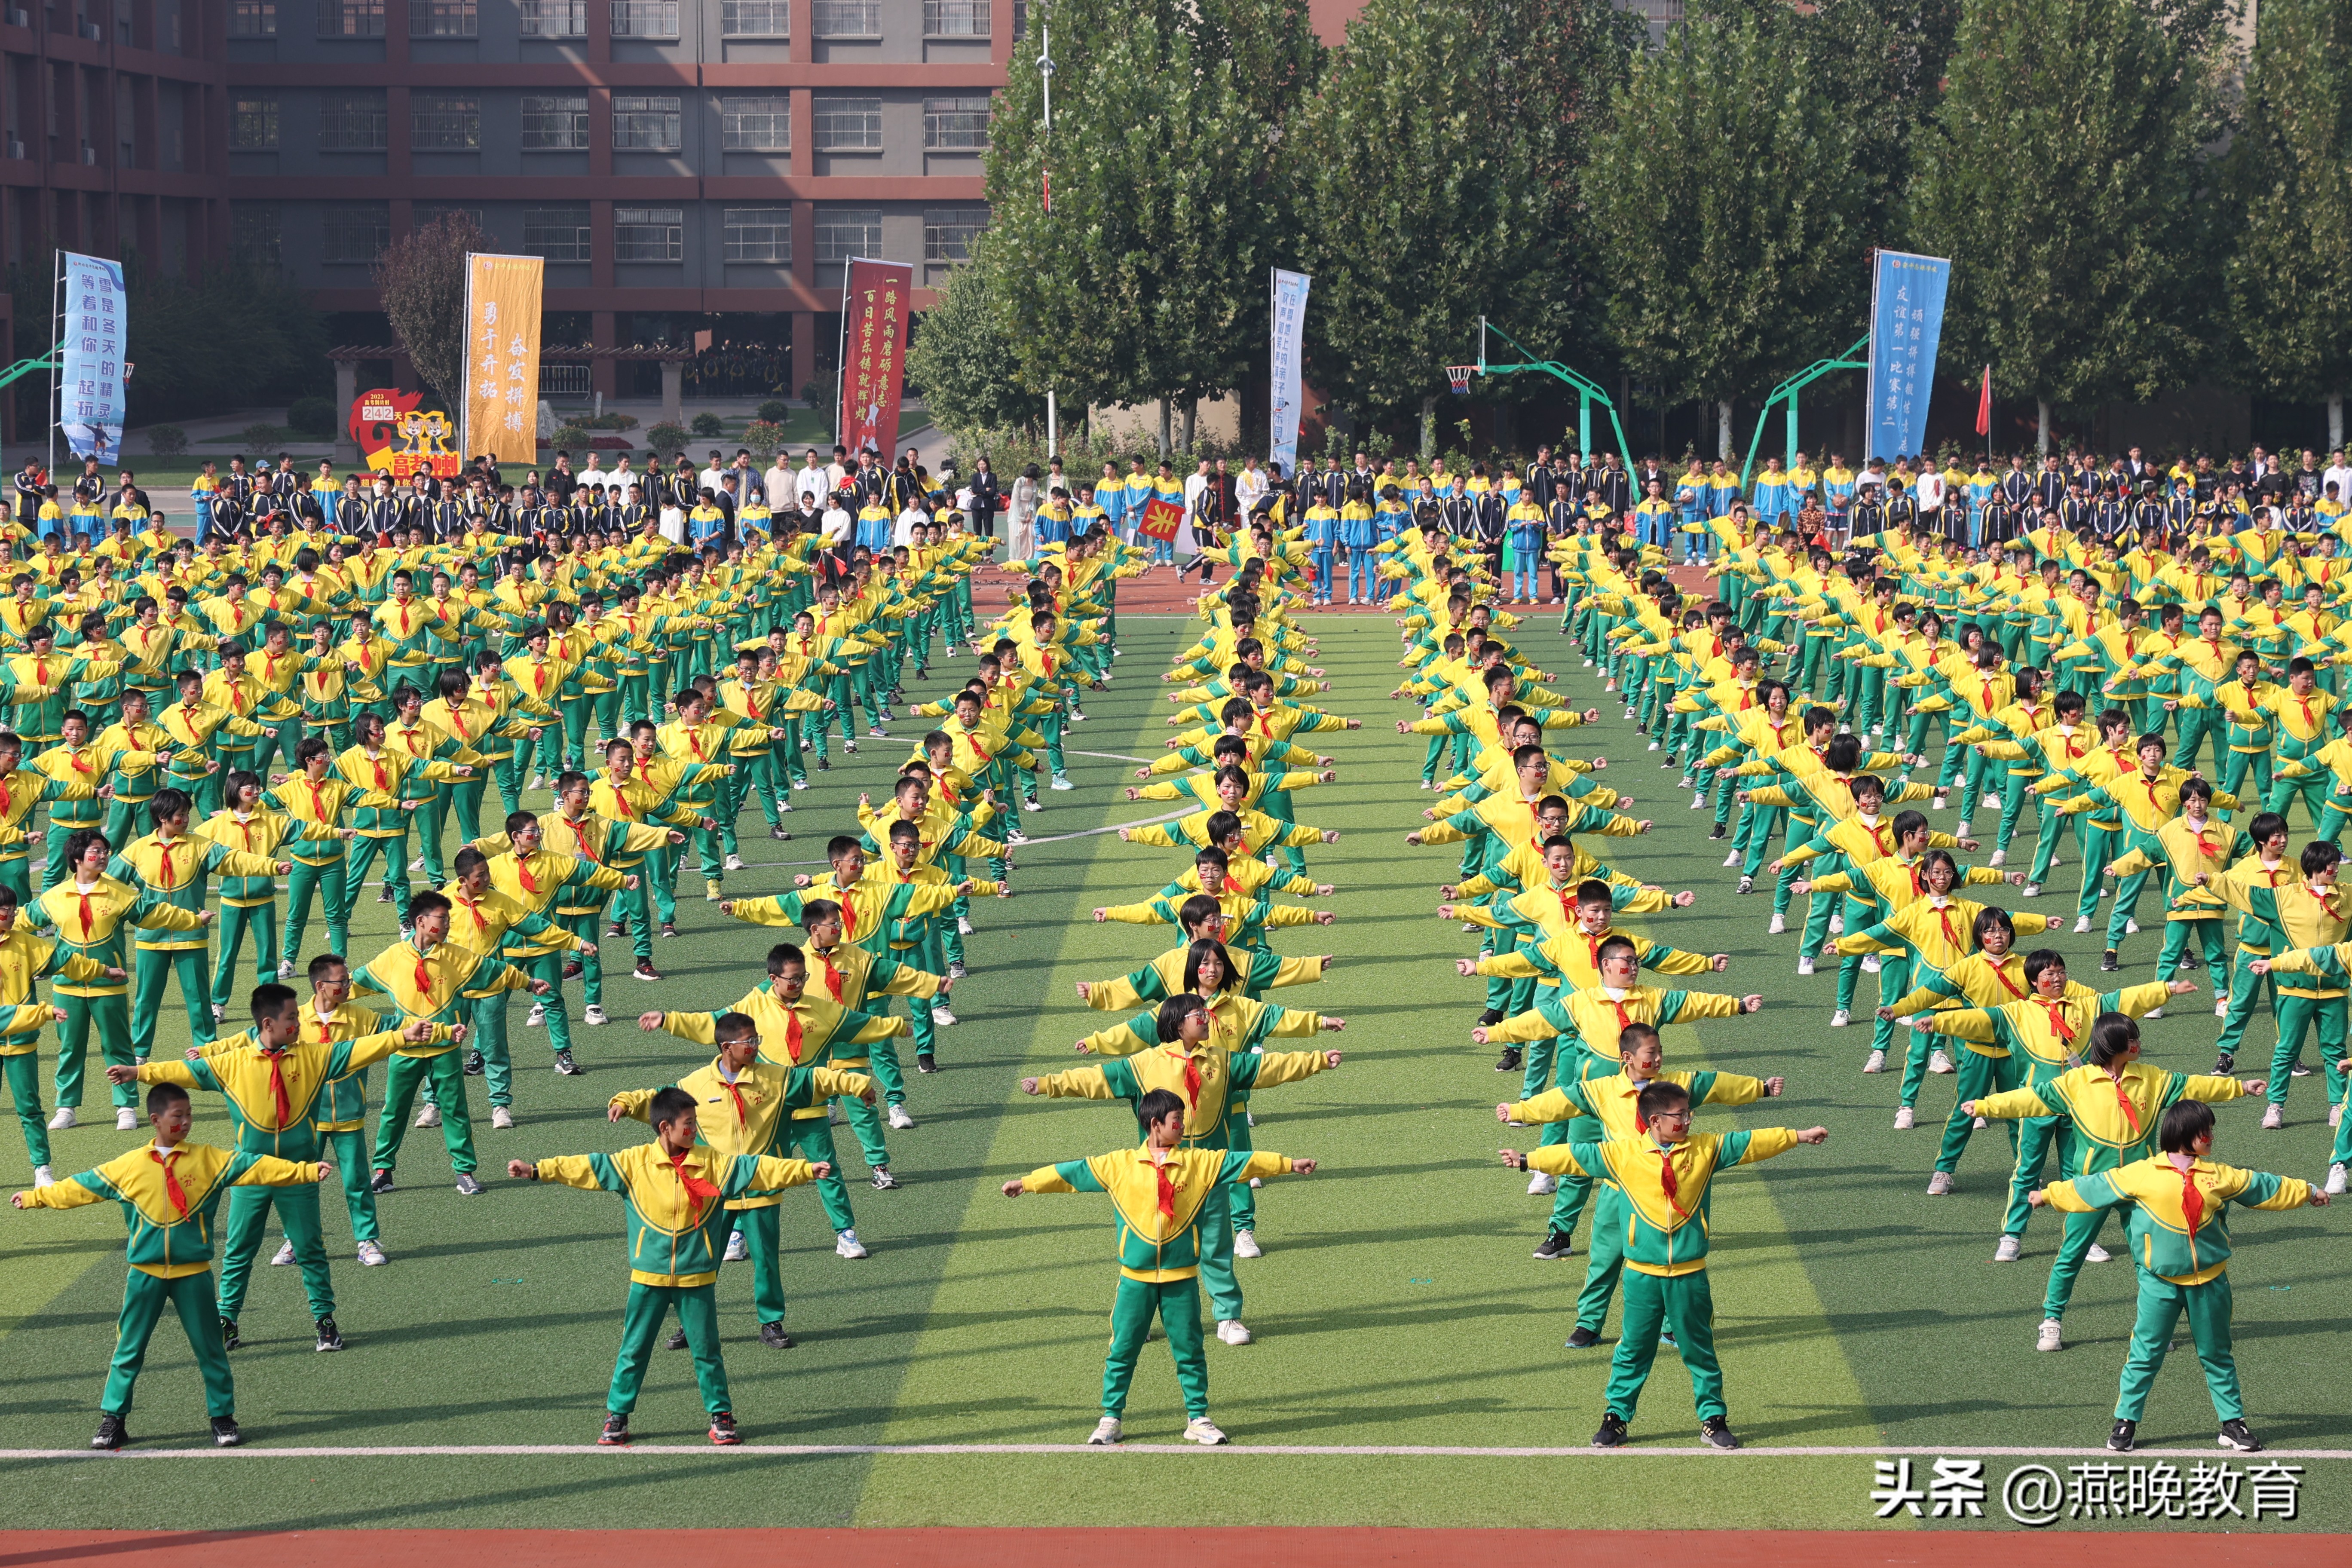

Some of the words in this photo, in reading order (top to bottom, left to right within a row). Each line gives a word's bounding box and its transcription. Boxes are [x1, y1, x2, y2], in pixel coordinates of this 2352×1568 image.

[77, 274, 98, 417] 等着和你一起玩
[98, 277, 116, 420] 雪是冬天的精灵
[479, 301, 498, 400] 勇于开拓
[504, 333, 528, 433] 奋发拼搏
[855, 290, 876, 421] 百日苦乐铸就辉煌
[876, 279, 898, 407] 一路风雨磨砺意志
[1274, 294, 1296, 438] 在雪地上的亲子游乐园
[1882, 285, 1908, 426] 友谊第一比赛第二
[1899, 309, 1923, 452] 顽强拼搏锻炼意志
[364, 408, 392, 419] 242
[394, 411, 402, 421] 天
